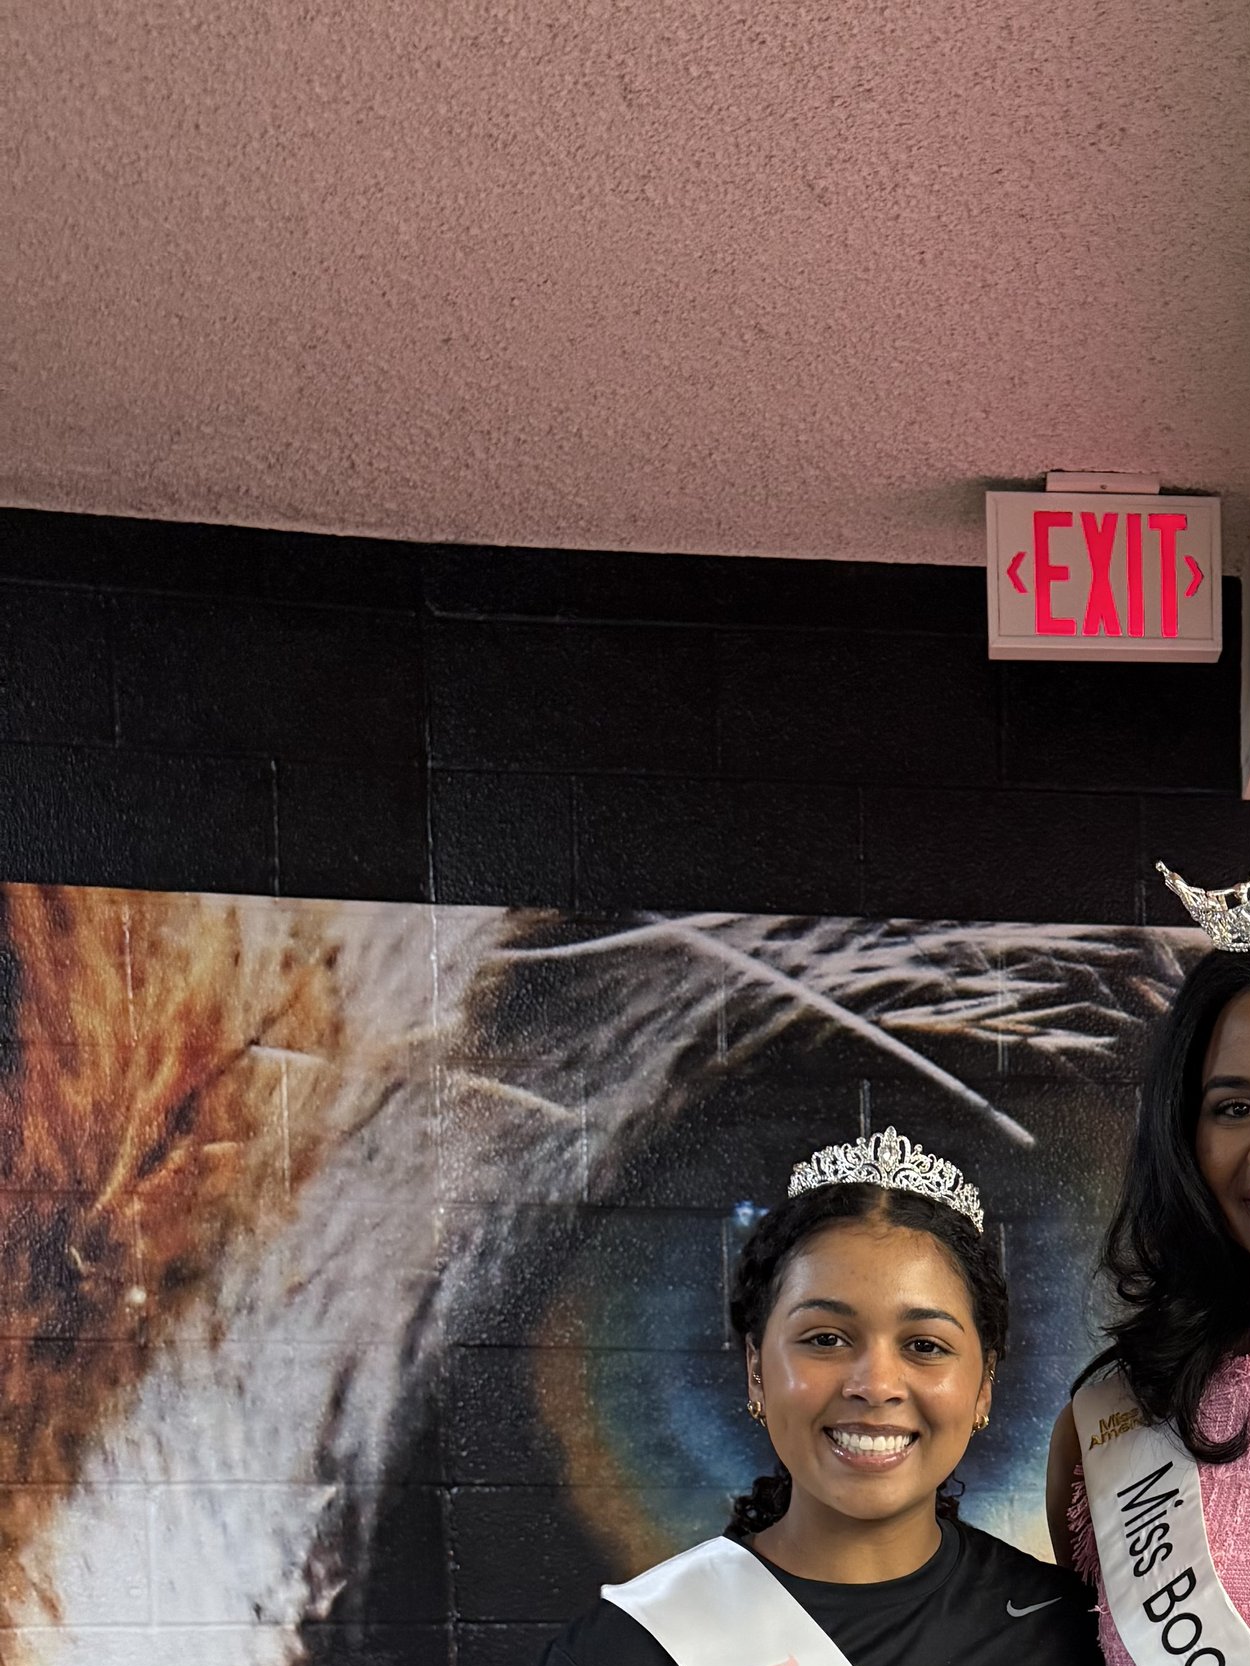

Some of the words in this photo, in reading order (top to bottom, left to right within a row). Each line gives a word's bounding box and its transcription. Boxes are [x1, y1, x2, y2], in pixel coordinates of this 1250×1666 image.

[1033, 511, 1187, 637] EXIT
[1099, 1407, 1141, 1433] Miss
[1117, 1461, 1184, 1578] Miss
